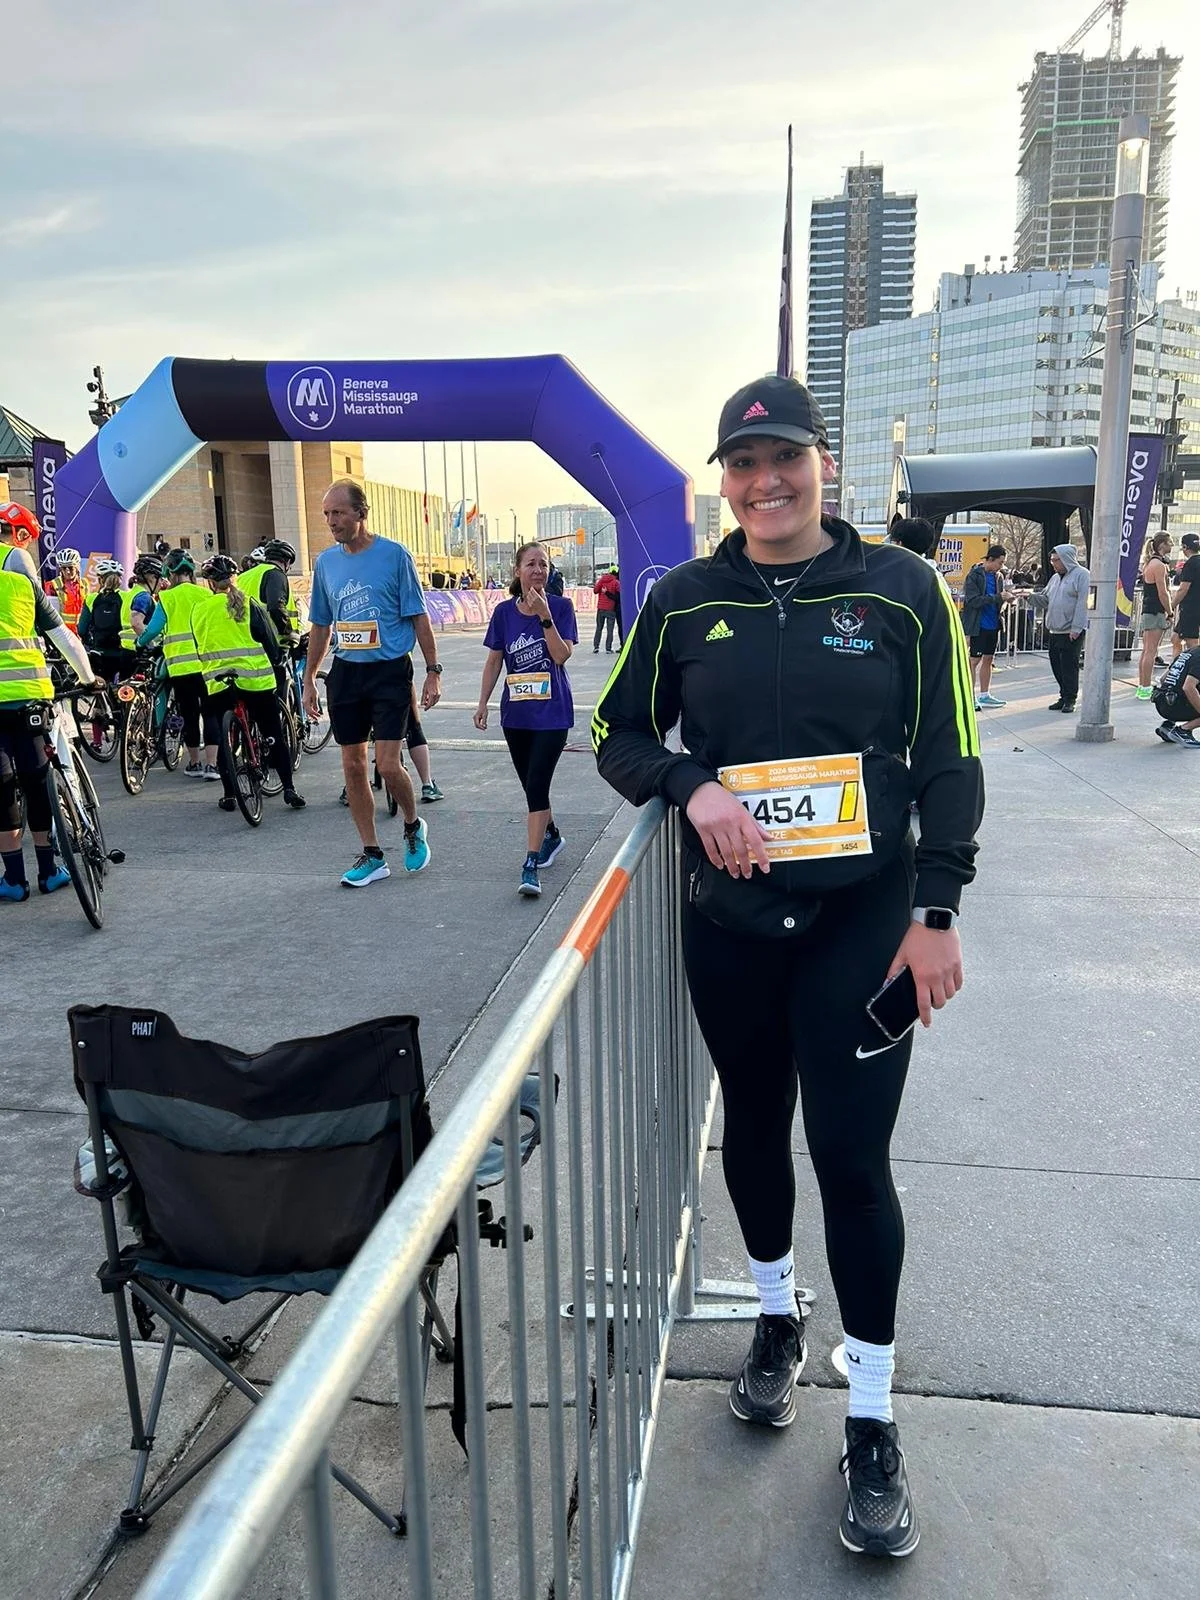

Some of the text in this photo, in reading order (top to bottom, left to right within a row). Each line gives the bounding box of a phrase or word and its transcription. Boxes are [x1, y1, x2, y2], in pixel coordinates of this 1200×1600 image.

[343, 378, 389, 389] Beneva
[343, 390, 419, 404] Mississauga
[344, 403, 404, 415] Marathon
[939, 538, 963, 551] Chip
[939, 552, 962, 562] TIME
[343, 594, 370, 612] CIRCUS
[341, 633, 363, 643] 1522
[705, 630, 734, 642] adidas
[822, 636, 875, 651] GAJOK
[515, 646, 543, 664] CIRCUS
[840, 842, 859, 850] 1454
[131, 1021, 153, 1036] PHAT
